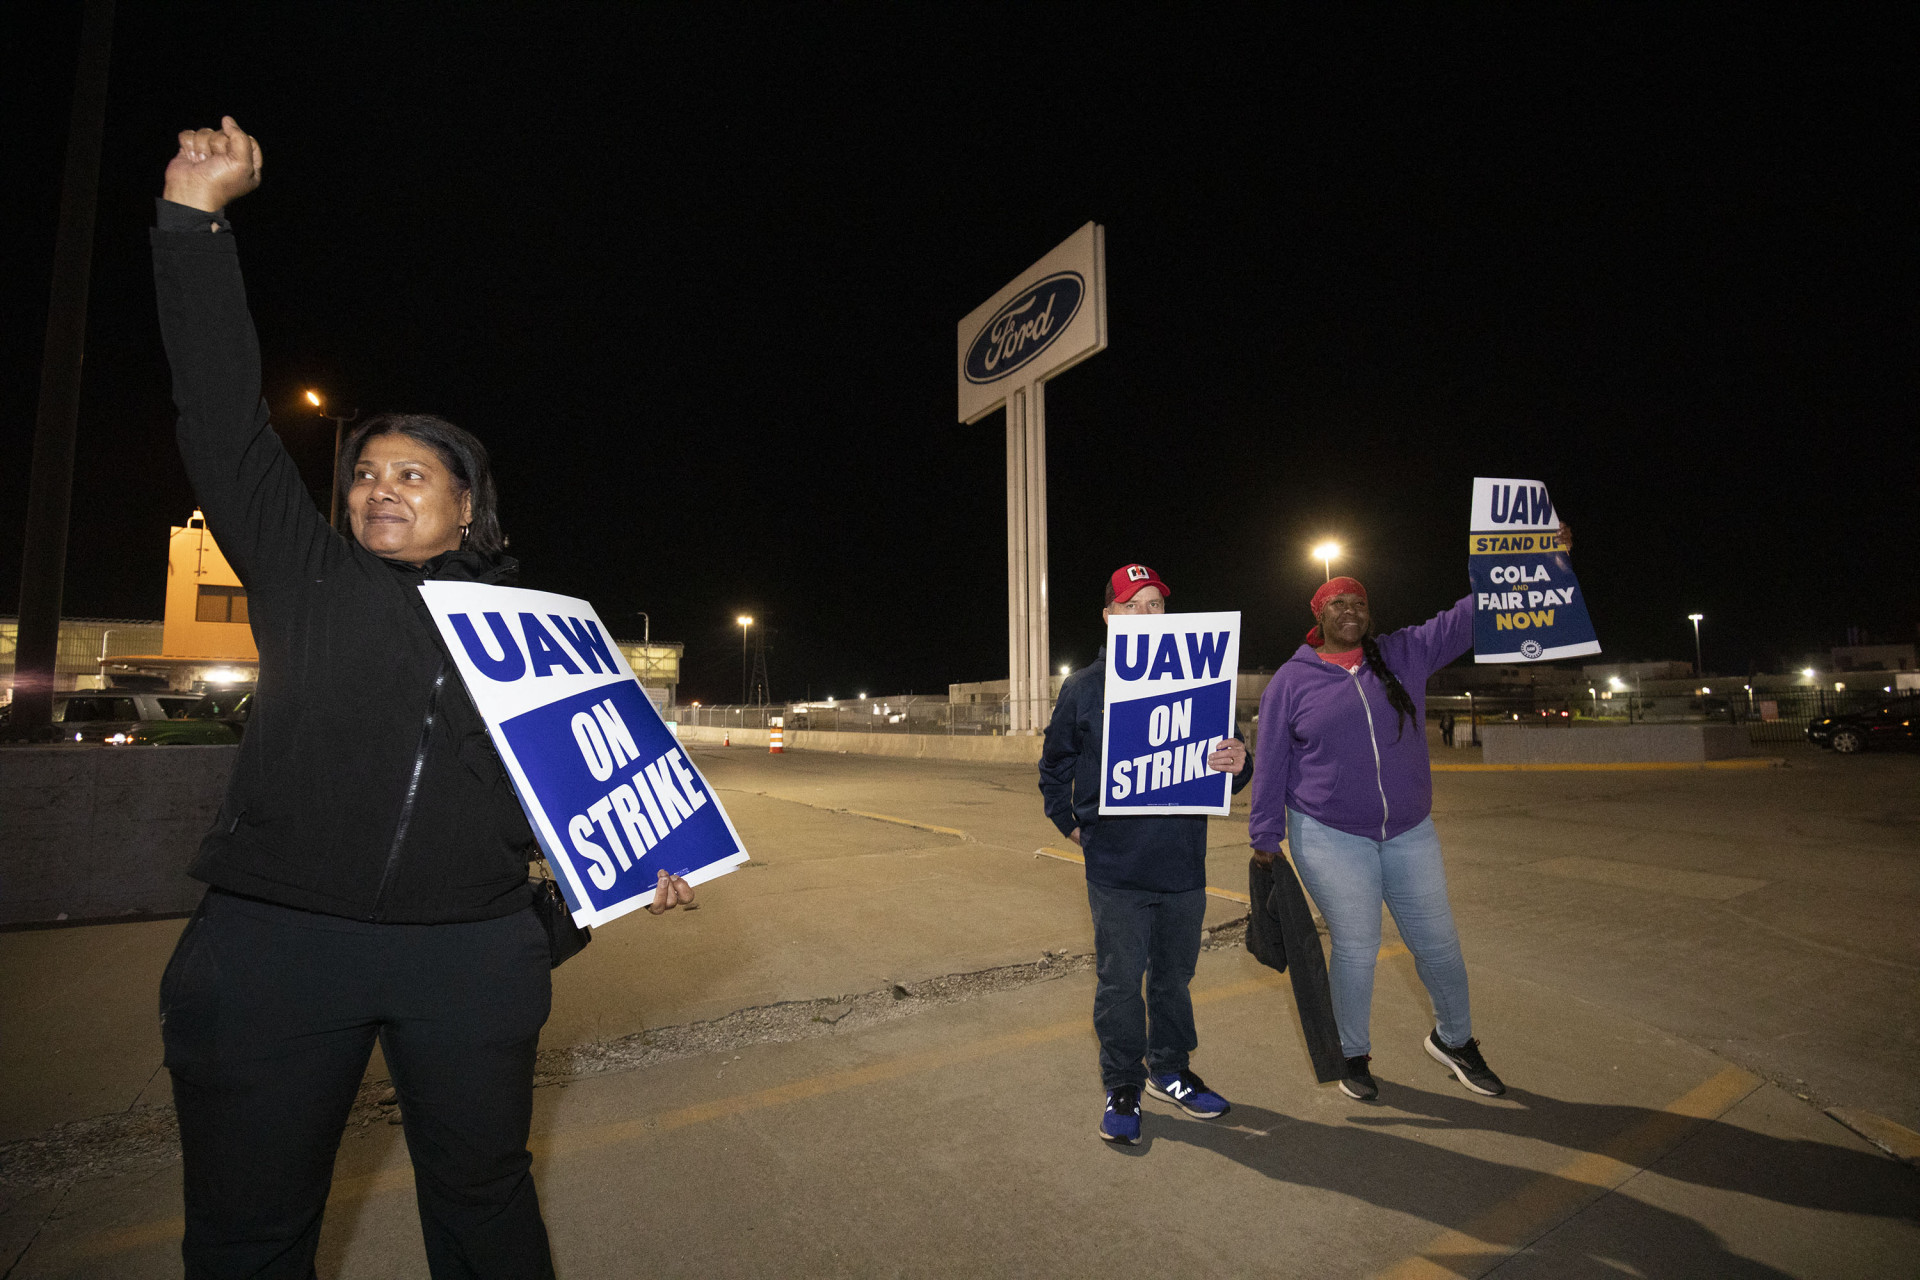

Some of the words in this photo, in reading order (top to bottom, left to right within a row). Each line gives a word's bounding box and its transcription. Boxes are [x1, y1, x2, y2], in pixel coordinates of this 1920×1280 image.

[984, 293, 1056, 371] Ford
[1491, 485, 1552, 525] UAW
[1477, 537, 1534, 551] STAND
[1478, 592, 1524, 610] FAIR
[1528, 587, 1574, 608] PAY
[1490, 564, 1551, 584] COLA
[1496, 609, 1555, 631] NOW
[448, 611, 620, 682] UAW
[1114, 631, 1230, 681] UAW
[570, 698, 640, 782] ON
[1148, 697, 1192, 747] ON
[568, 747, 707, 891] STRIKE
